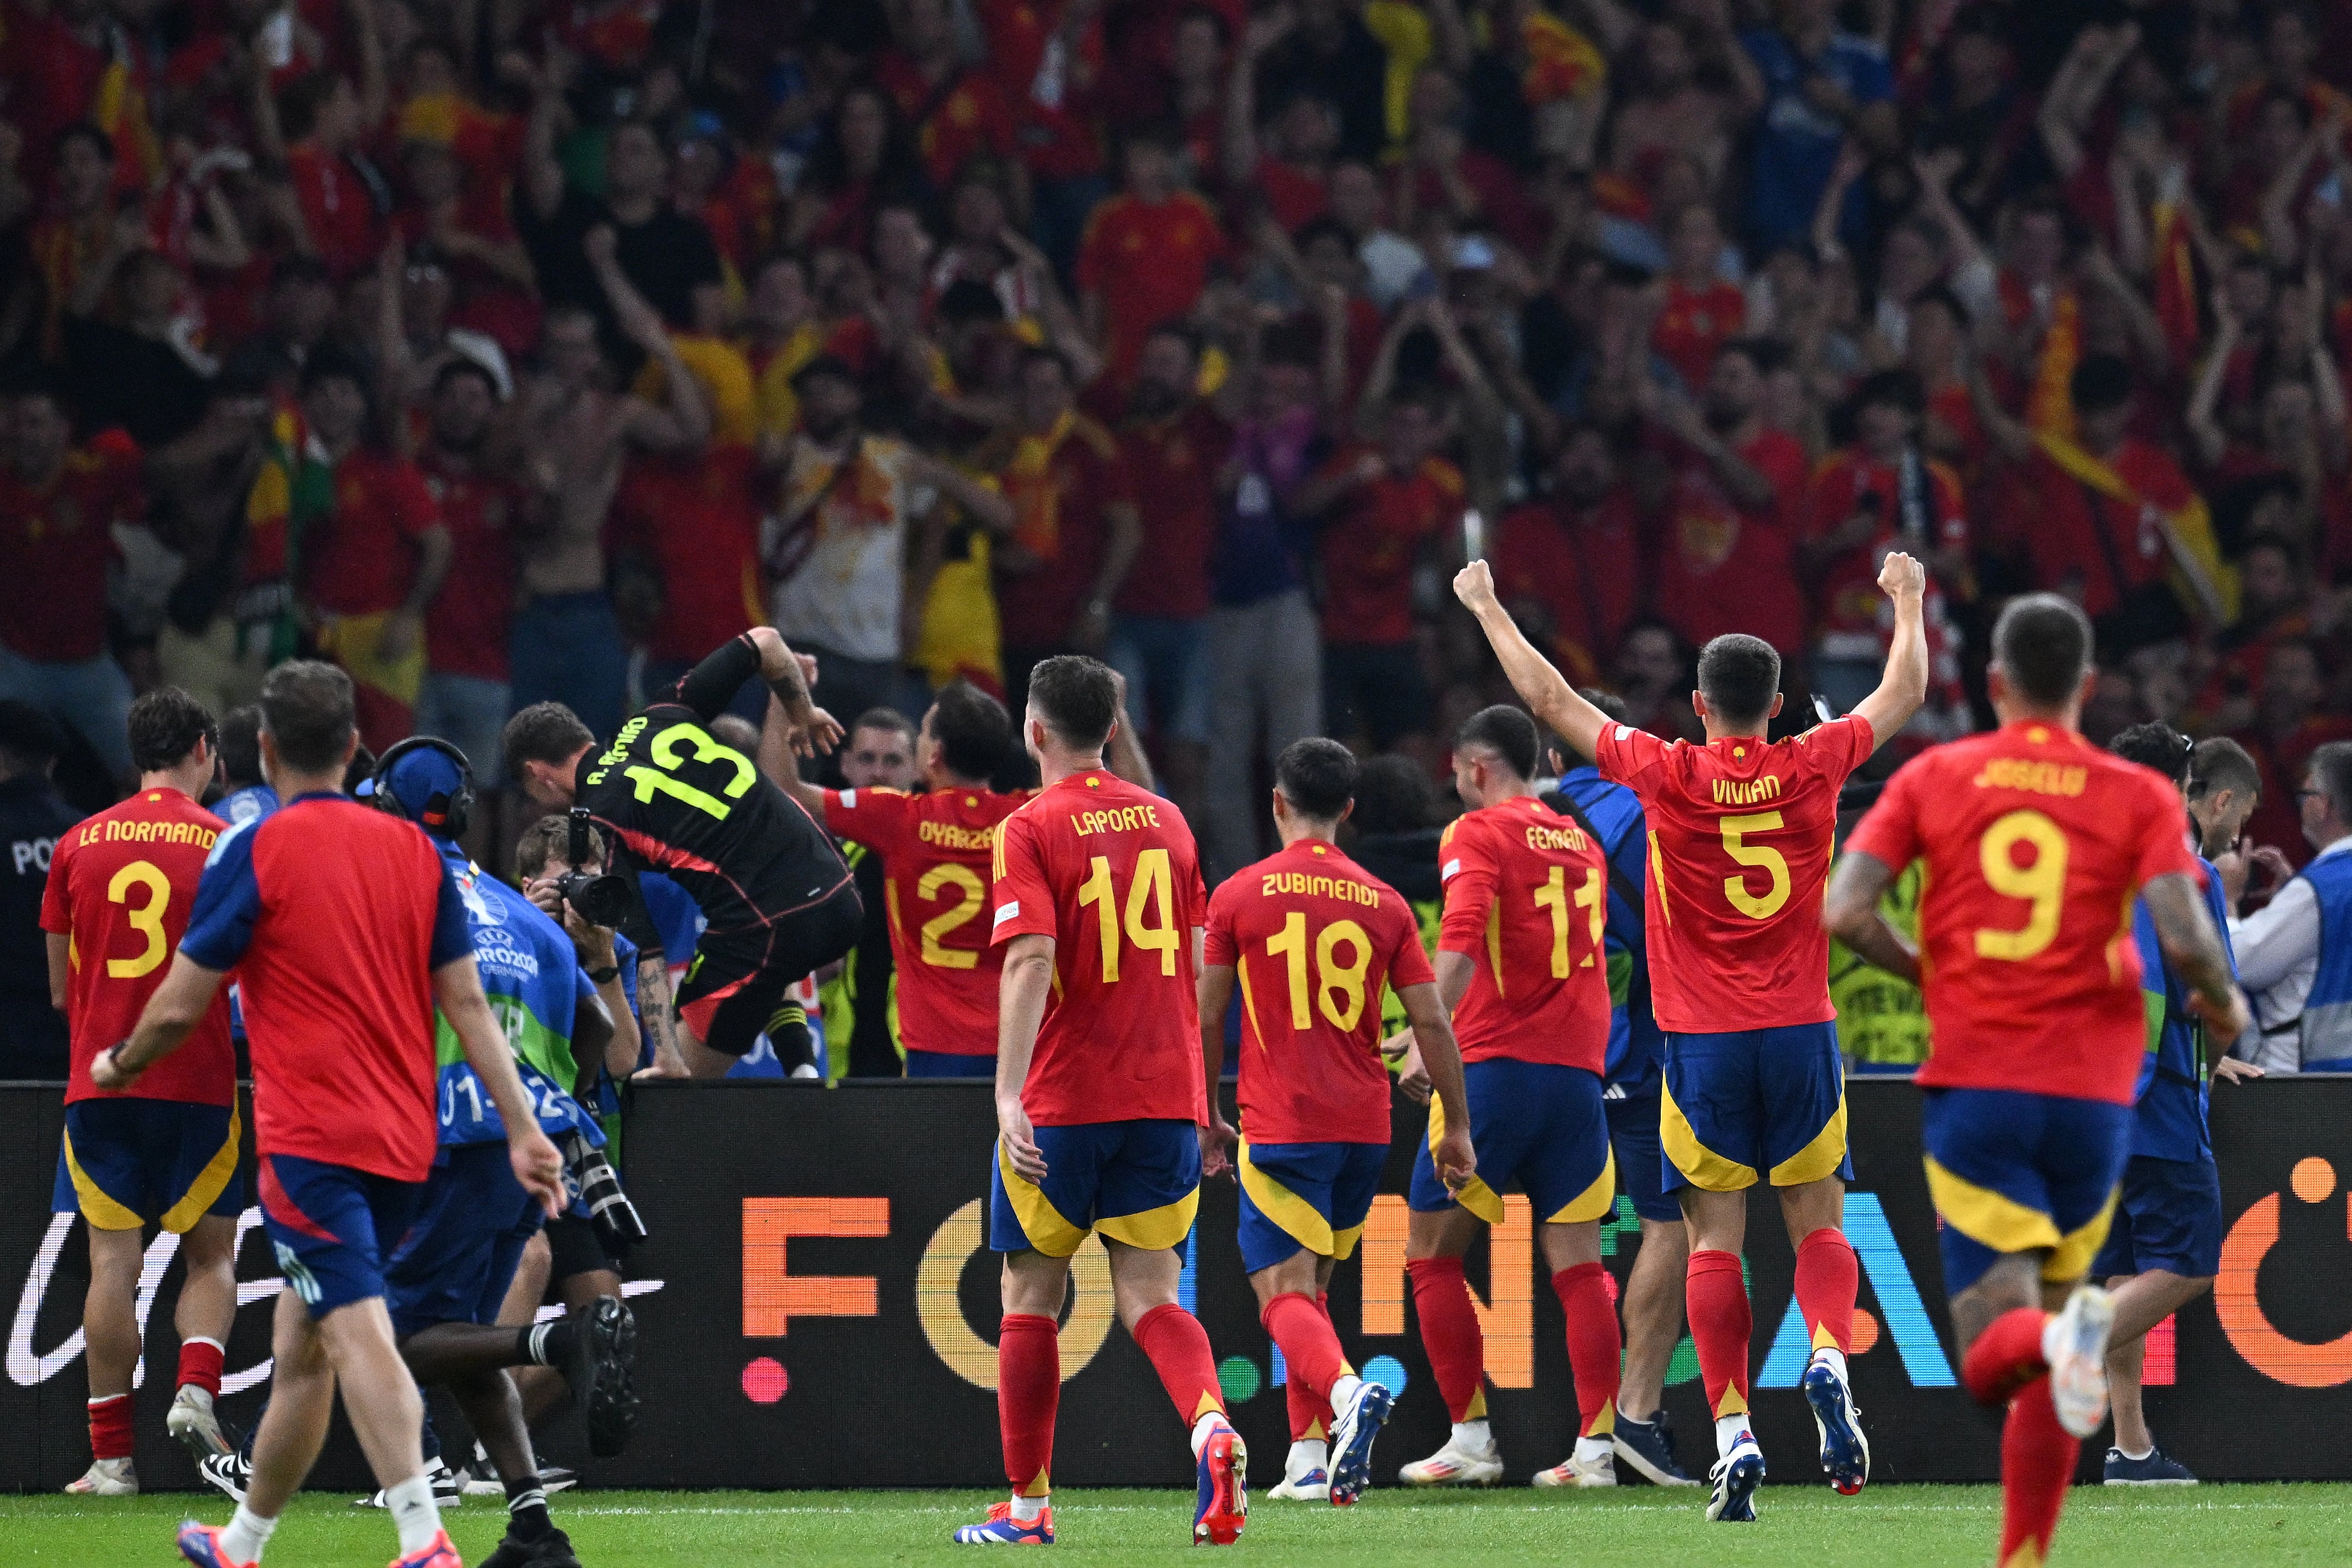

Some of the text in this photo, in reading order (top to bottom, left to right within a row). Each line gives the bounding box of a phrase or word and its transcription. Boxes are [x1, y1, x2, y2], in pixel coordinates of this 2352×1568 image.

[623, 722, 757, 821] 13
[1071, 805, 1160, 837] LAPORTE
[1712, 775, 1781, 804] VIVIAN
[79, 820, 218, 850] LE NORMAND
[918, 820, 994, 850] OYARZA
[1526, 826, 1588, 851] FERRAN
[1720, 810, 1791, 920] 5
[107, 860, 172, 978] 3
[1078, 849, 1179, 983] 14
[1262, 872, 1379, 908] ZUBIMENDI
[1534, 866, 1604, 979] 11
[1974, 808, 2069, 962] 9
[1266, 911, 1373, 1033] 18
